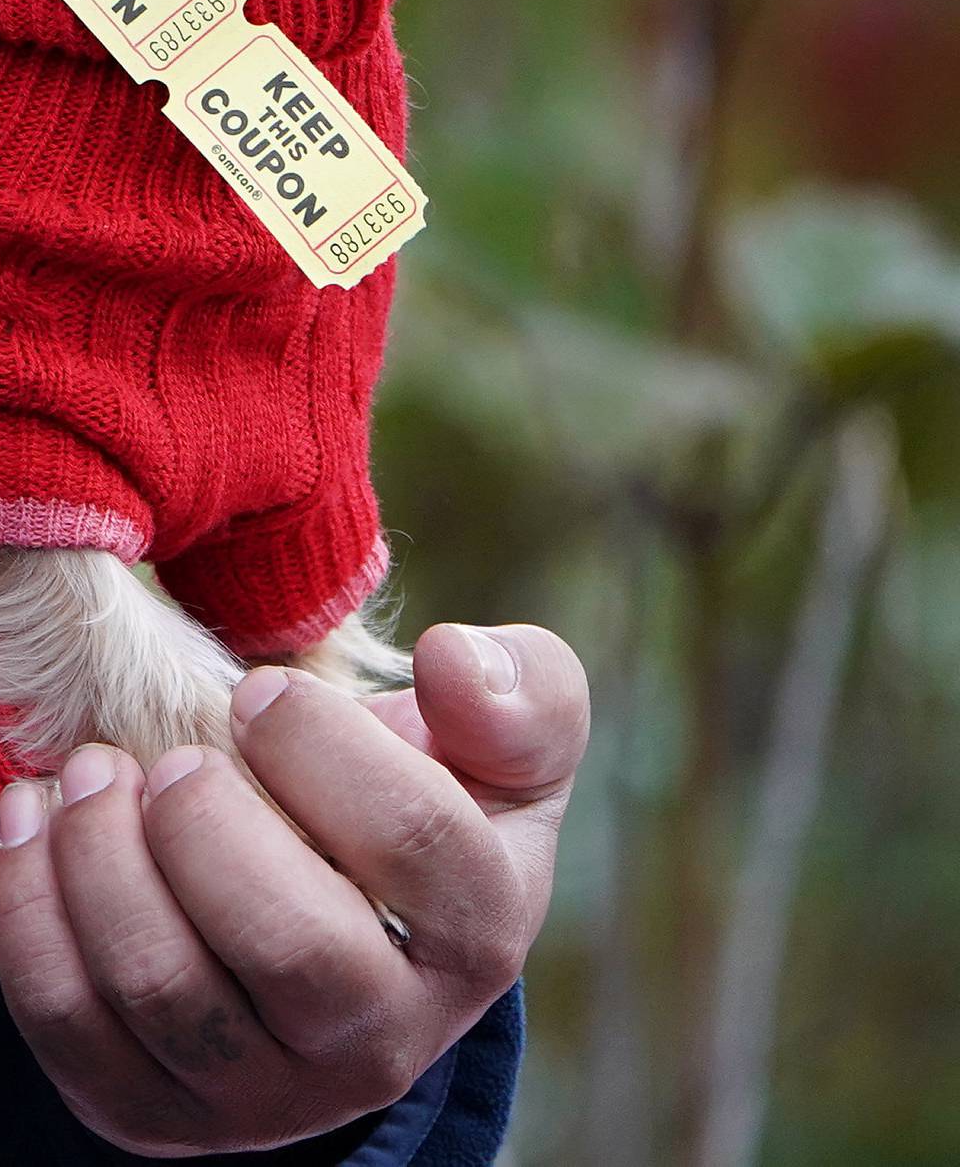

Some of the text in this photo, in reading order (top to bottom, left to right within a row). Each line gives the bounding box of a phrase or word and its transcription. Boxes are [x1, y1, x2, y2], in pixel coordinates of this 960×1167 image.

[258, 106, 308, 162] THIS
[262, 71, 350, 159] KEEP
[201, 88, 327, 228] COUPON
[329, 192, 405, 265] 933788
